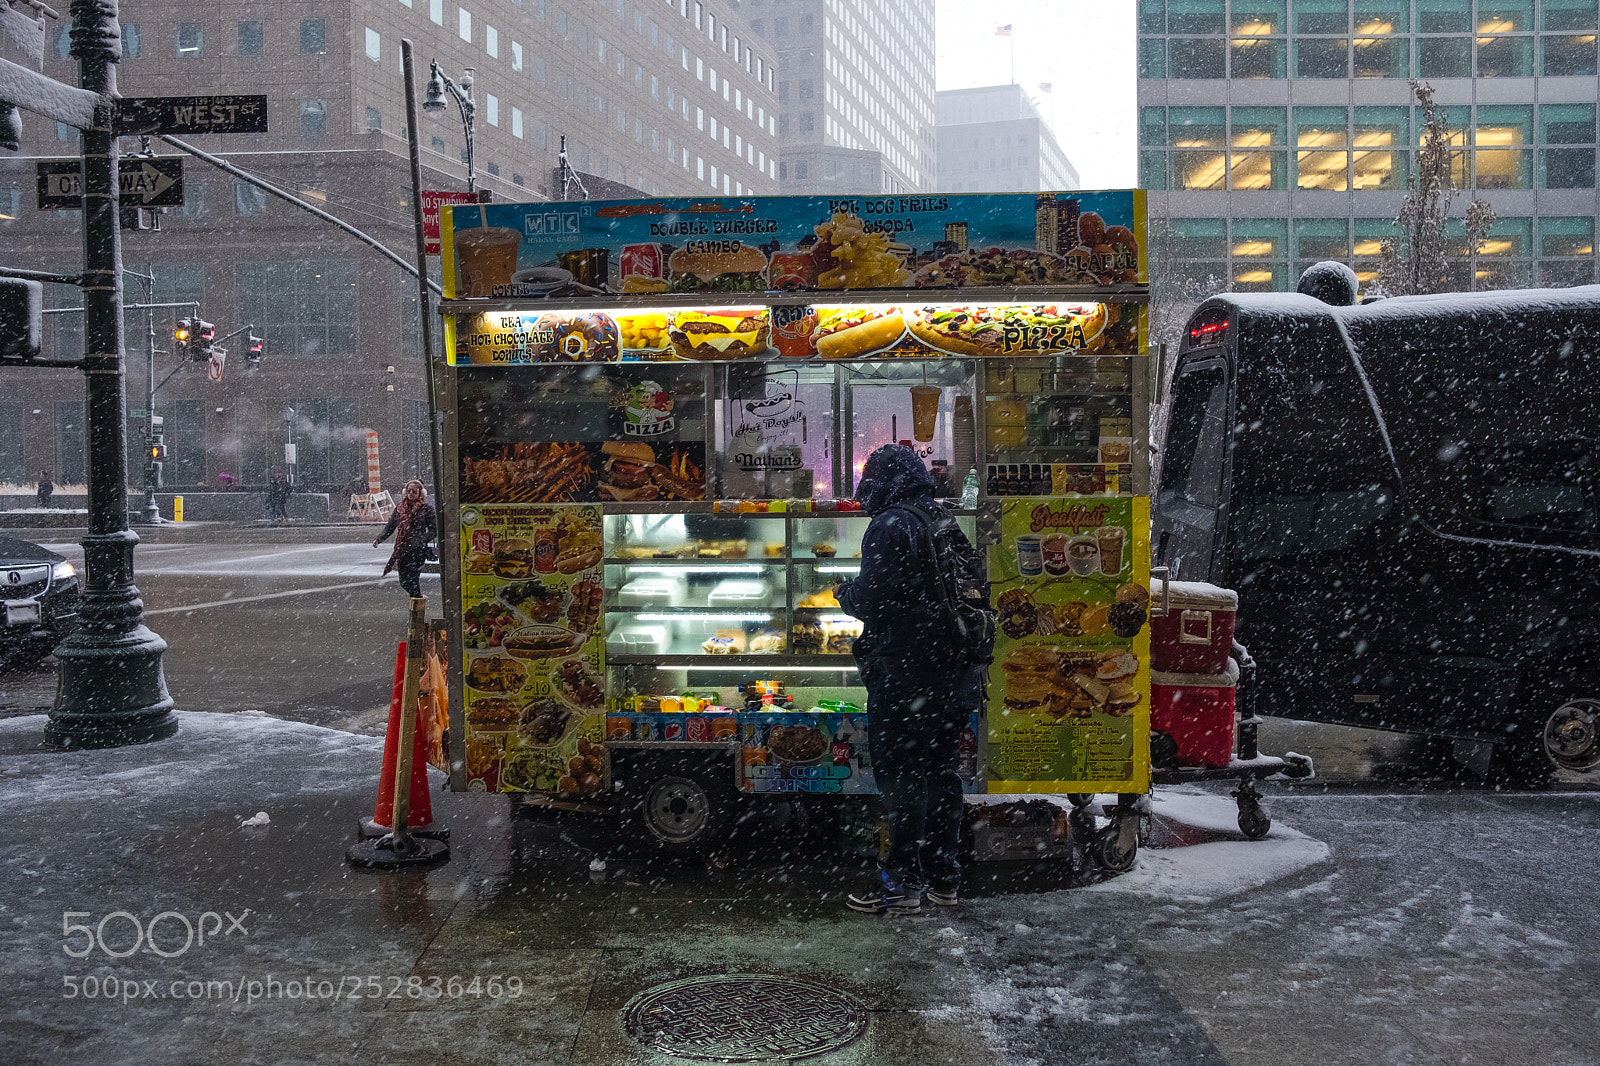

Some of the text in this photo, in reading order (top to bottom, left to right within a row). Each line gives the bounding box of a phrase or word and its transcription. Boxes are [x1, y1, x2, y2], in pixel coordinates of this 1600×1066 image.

[174, 104, 256, 124] WEST ST
[59, 174, 160, 194] ON WAY
[422, 197, 431, 209] NO
[828, 199, 860, 214] HOT
[526, 214, 578, 234] WTC
[649, 219, 778, 236] DOUBLE BURGER
[687, 240, 741, 255] CAMBO
[491, 284, 530, 295] COFFEE
[500, 316, 523, 329] TEA
[470, 331, 554, 346] HOT CHOCOLATE
[1002, 325, 1089, 354] PIZZA
[626, 420, 673, 435] PIZZA
[735, 452, 802, 467] Nathan's
[1030, 503, 1110, 534] Breakfast
[744, 765, 852, 779] ICE COLD
[753, 779, 843, 793] DRINKS
